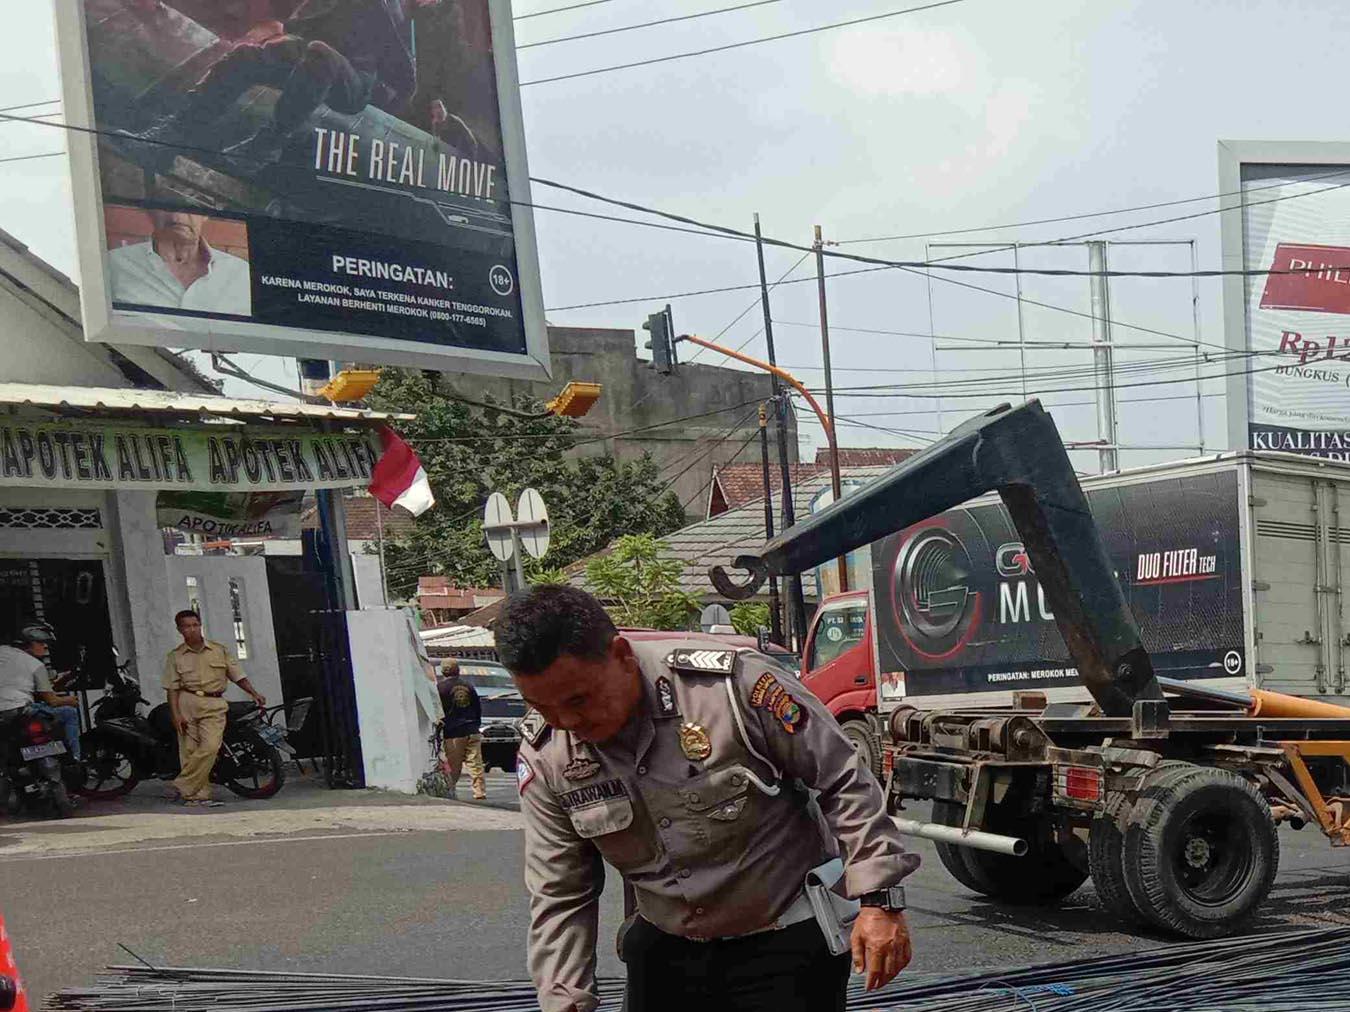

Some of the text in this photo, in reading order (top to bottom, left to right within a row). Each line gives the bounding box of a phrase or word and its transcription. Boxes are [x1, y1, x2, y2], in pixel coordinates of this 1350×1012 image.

[314, 127, 497, 204] THE REAL MOVE
[332, 255, 454, 289] PERINGATAN:
[261, 275, 302, 289] KARENA
[303, 281, 352, 296] MEROKOK,
[353, 287, 376, 299] SAYA
[377, 291, 416, 304] TERKENA
[417, 296, 451, 309] KANKER
[298, 293, 340, 306] LAYANAN
[342, 300, 385, 313] BERHENTI
[386, 305, 429, 319] MEROKOK
[1275, 364, 1340, 383] BUNGKUS
[2, 429, 112, 481] APOTEK
[114, 432, 195, 482] ALIFA
[208, 437, 314, 483] APOTEK
[1137, 548, 1216, 580] DUO FILTER TECH
[987, 672, 1030, 682] PERINGATAN:
[1031, 668, 1065, 679] MEROKOK
